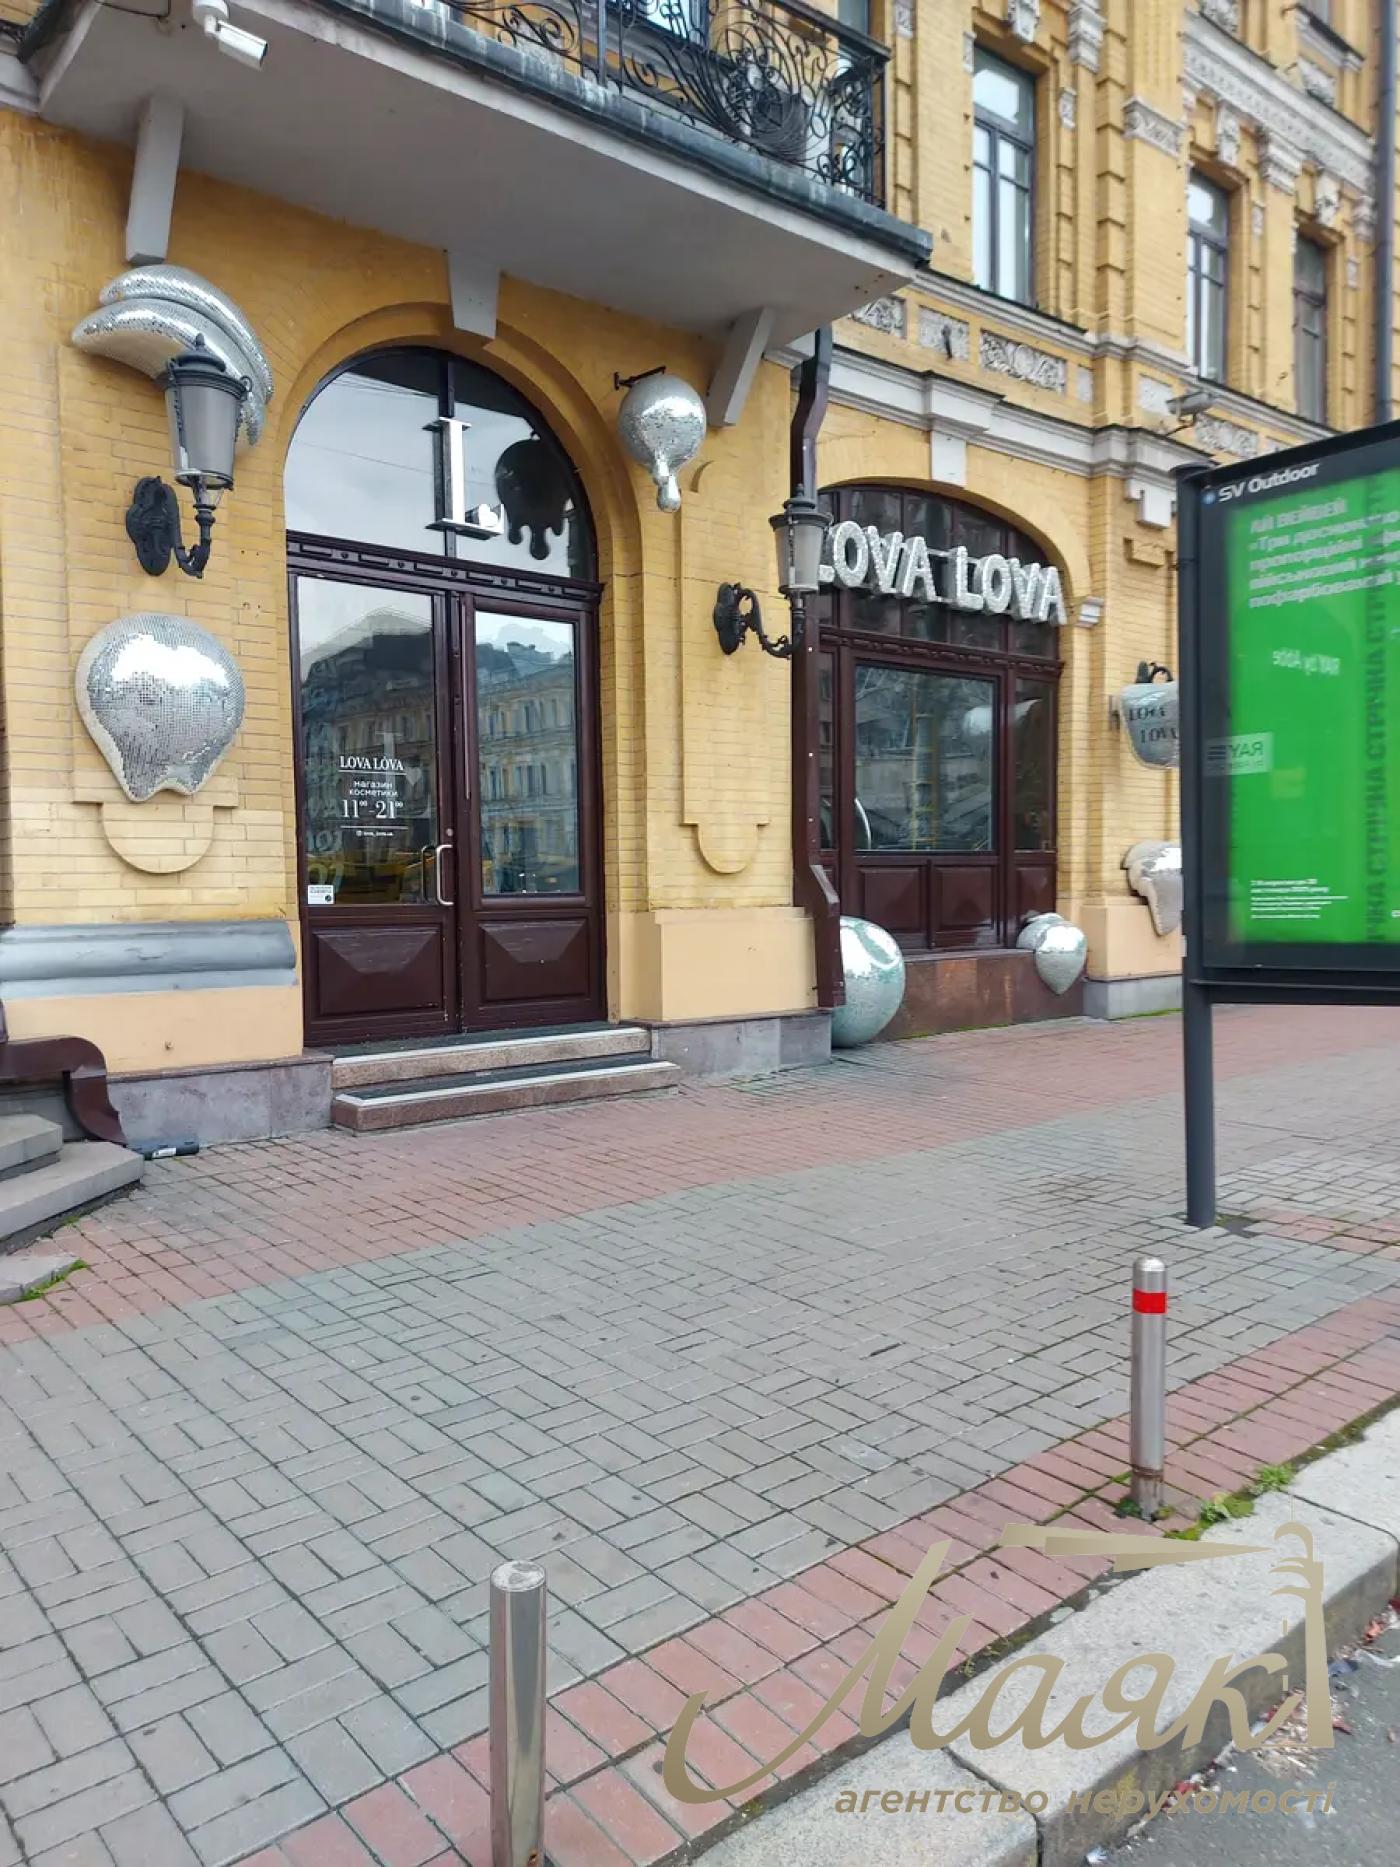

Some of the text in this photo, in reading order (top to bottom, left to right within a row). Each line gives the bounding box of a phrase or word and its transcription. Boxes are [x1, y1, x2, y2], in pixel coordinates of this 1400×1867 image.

[1218, 463, 1320, 502] SV Outdoor
[955, 545, 1067, 625] LOVA
[340, 755, 371, 769] LOVA
